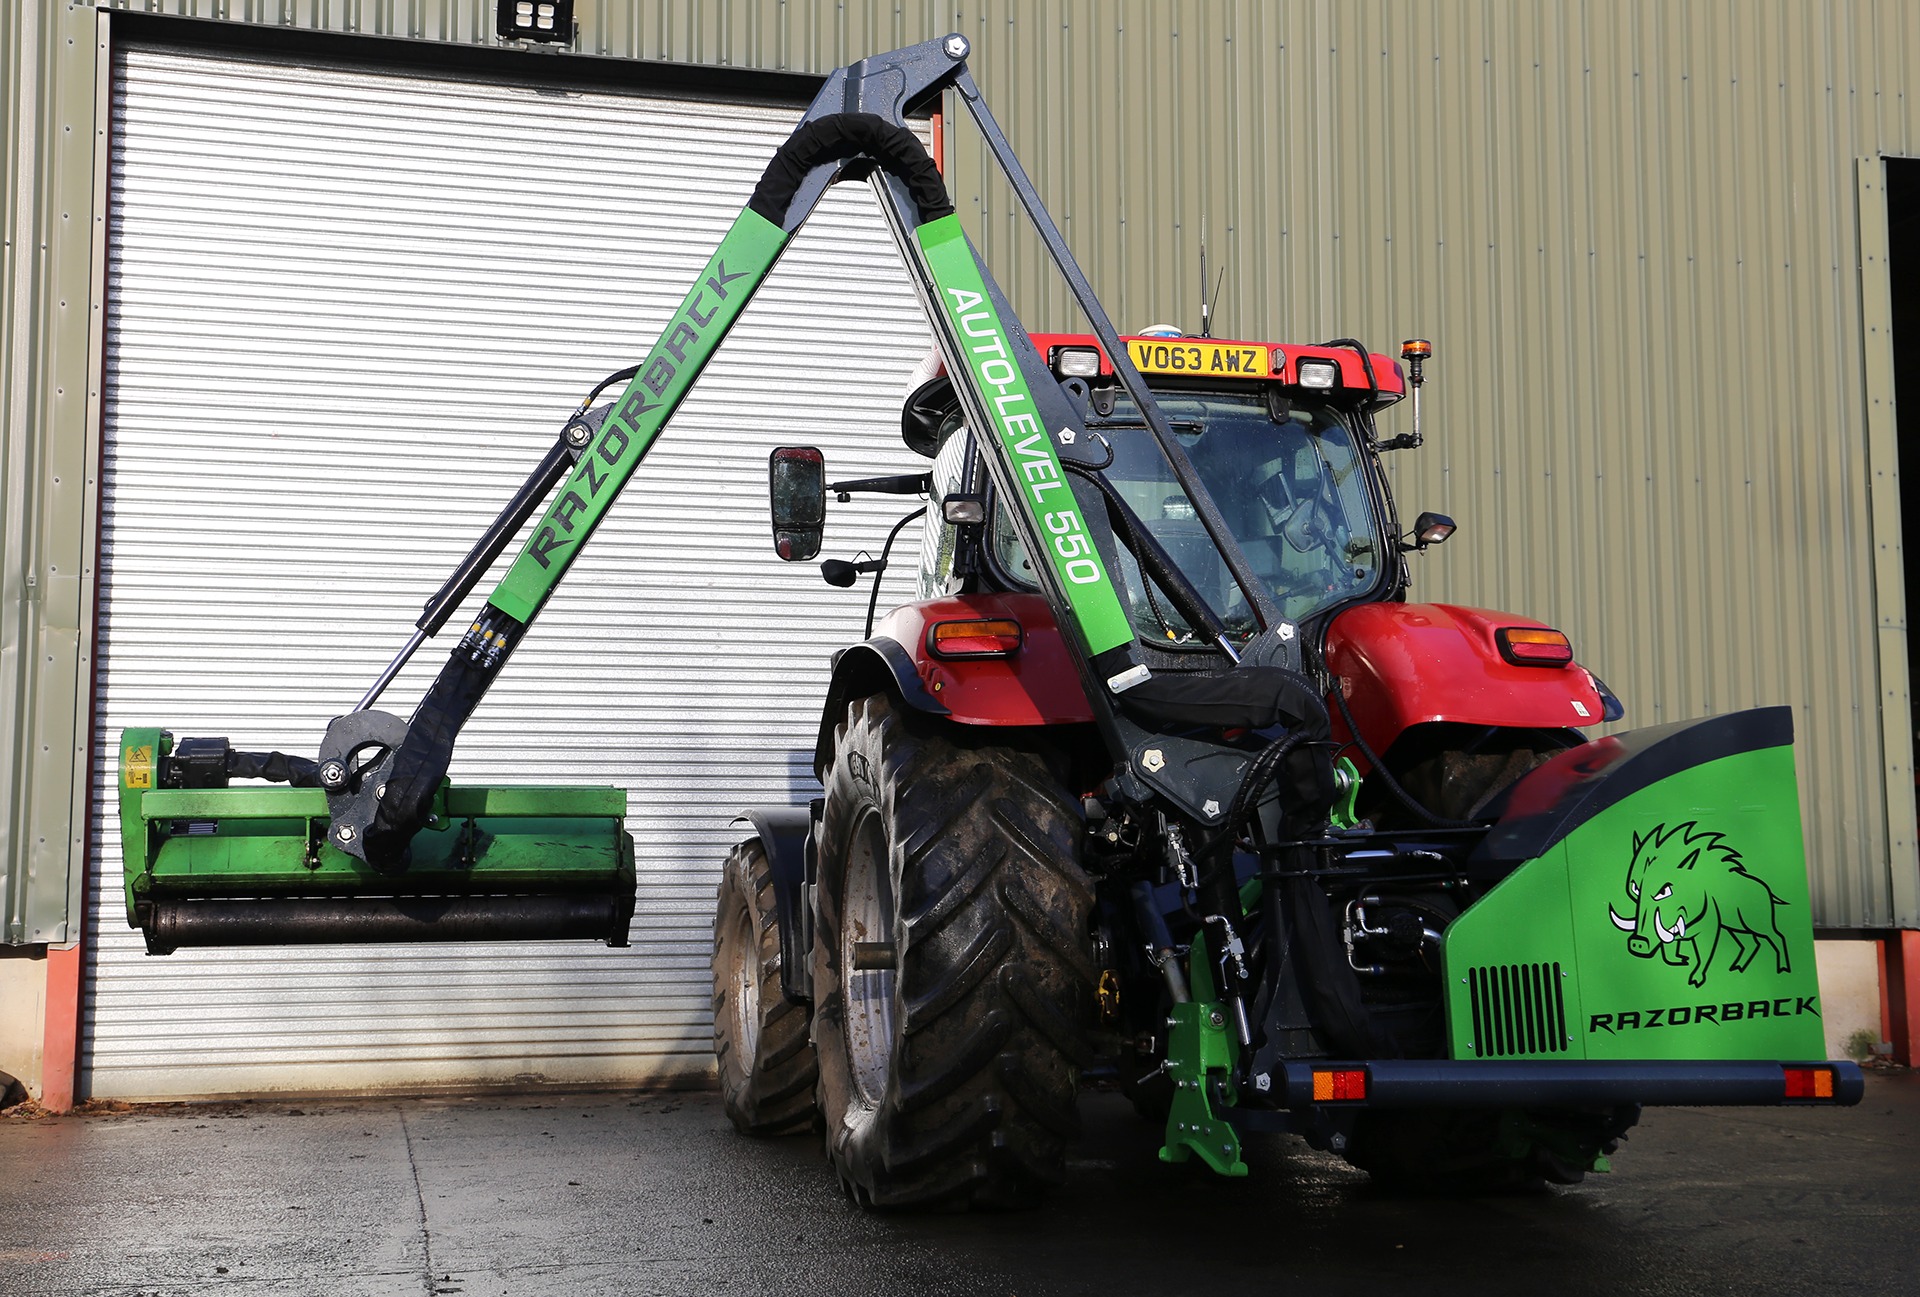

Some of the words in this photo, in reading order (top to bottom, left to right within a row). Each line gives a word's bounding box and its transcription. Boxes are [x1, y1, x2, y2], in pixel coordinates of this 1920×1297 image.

[527, 259, 751, 570] RAZORBACK
[947, 288, 1059, 504] AUTO-LEVEL
[1044, 511, 1101, 584] 550
[1138, 345, 1202, 370] VO63
[1210, 348, 1257, 373] AWZ
[1589, 996, 1822, 1036] RAZORBACK
